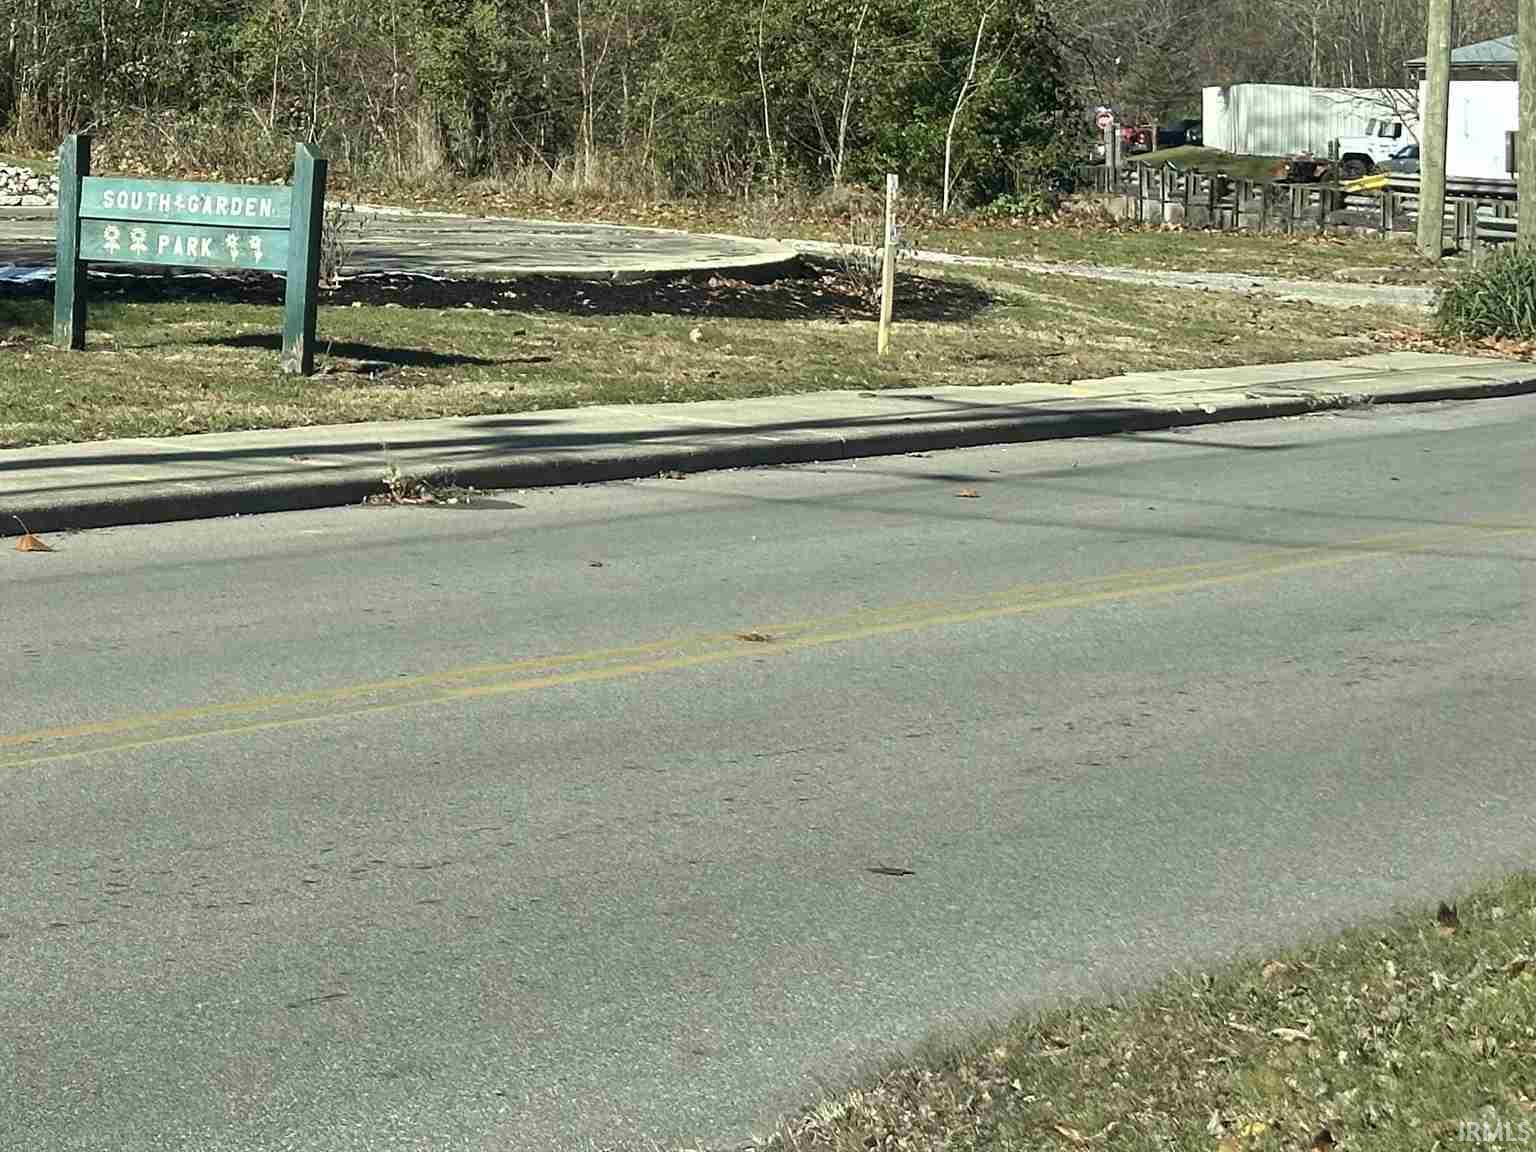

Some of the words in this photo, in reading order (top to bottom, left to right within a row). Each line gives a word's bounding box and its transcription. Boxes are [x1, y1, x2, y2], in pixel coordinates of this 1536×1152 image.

[102, 189, 171, 212] SOUTH
[187, 193, 273, 217] GARDEN
[157, 234, 213, 257] PARK
